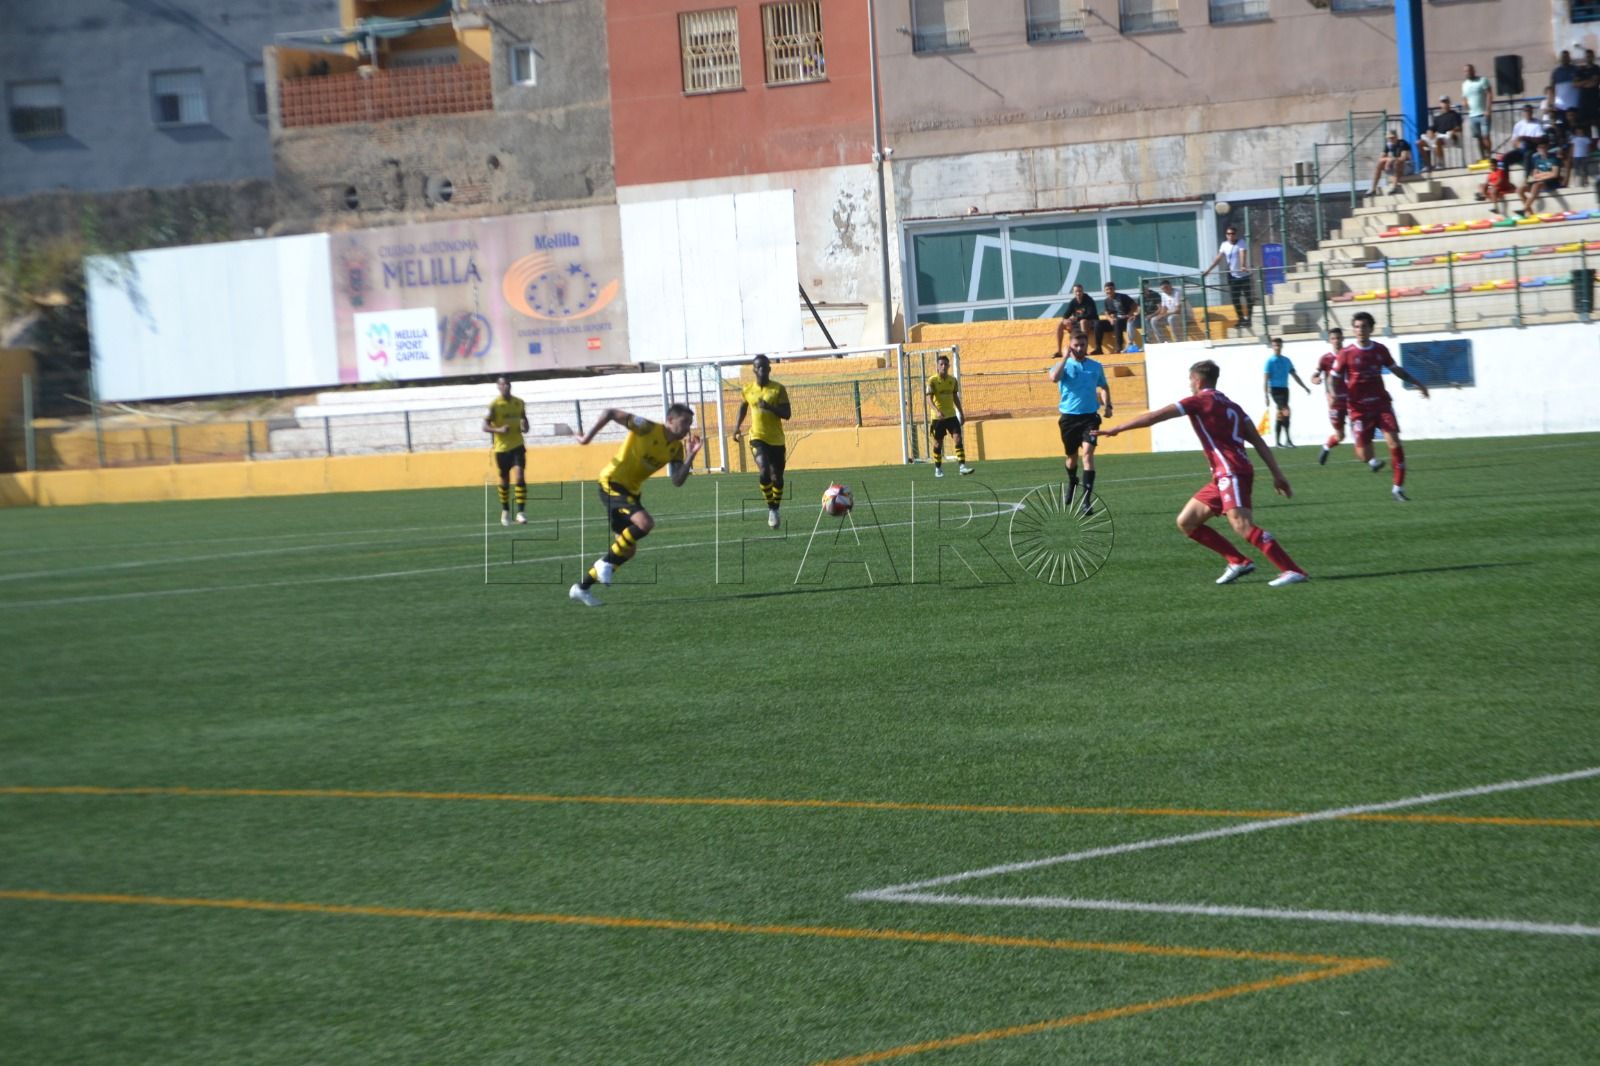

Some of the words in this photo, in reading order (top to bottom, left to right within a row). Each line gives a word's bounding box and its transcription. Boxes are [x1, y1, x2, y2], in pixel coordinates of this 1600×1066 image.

[534, 232, 580, 250] Melilla
[382, 256, 483, 289] MELILLA
[395, 328, 428, 339] MELILLA
[395, 340, 422, 351] SPORT
[396, 351, 431, 362] CAPITAL
[1226, 407, 1244, 444] 2
